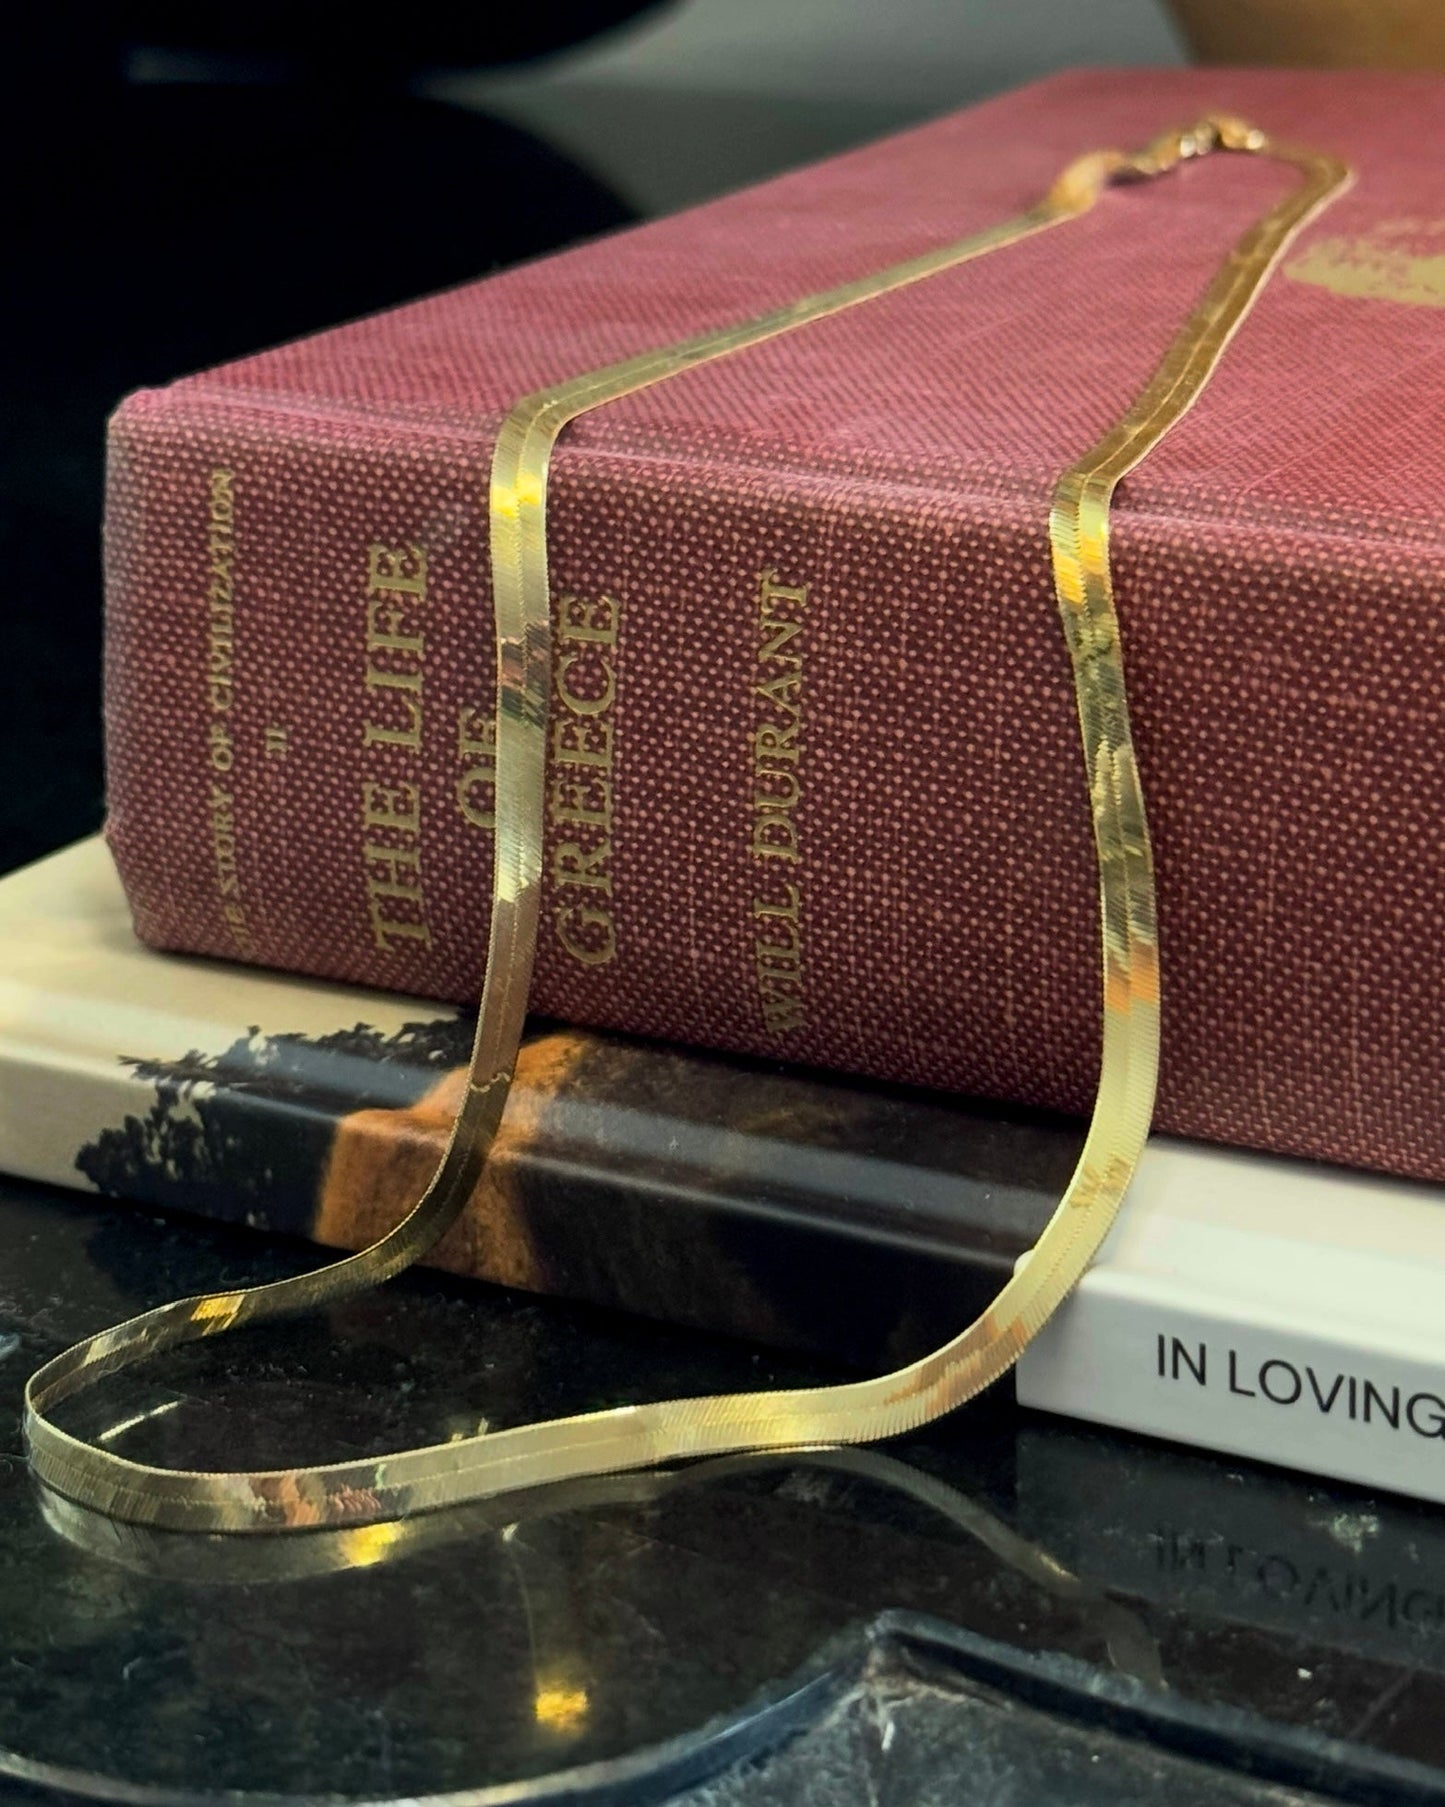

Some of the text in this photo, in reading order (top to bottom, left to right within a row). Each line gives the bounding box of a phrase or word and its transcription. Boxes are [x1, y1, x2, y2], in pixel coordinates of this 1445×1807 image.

[207, 468, 235, 711] CIVILIZATION
[207, 724, 234, 772] OF
[265, 726, 288, 754] II
[363, 543, 432, 952] THE LIFE
[553, 595, 620, 965] GREECE
[751, 567, 808, 1034] WILL DURANT
[208, 784, 241, 898] STORY
[1156, 1333, 1445, 1440] IN LOVING
